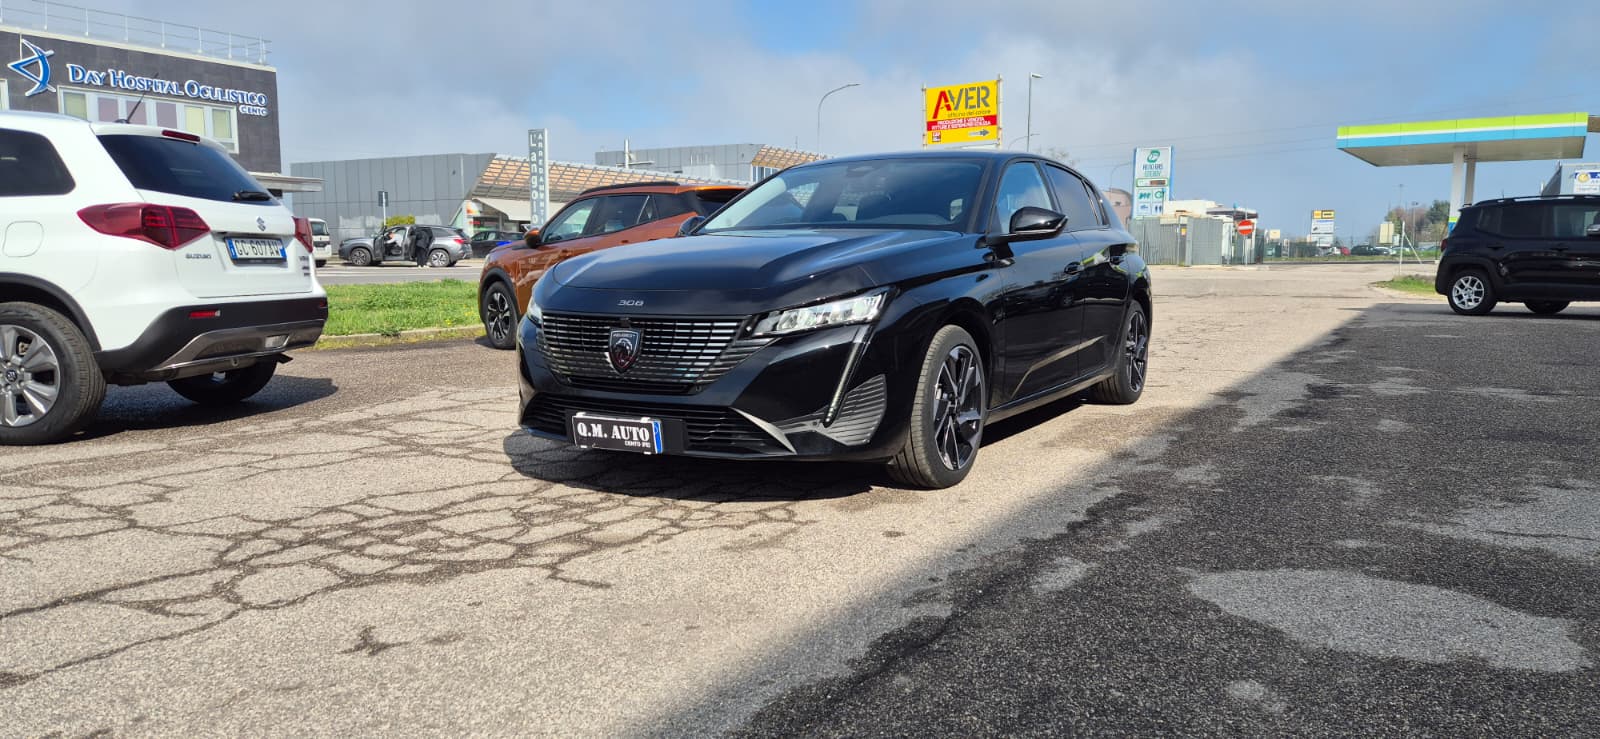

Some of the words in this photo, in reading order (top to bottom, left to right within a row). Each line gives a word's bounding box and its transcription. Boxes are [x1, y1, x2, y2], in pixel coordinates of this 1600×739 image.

[932, 86, 990, 119] AVER
[235, 240, 249, 256] GC
[577, 422, 608, 438] Q.M.
[611, 425, 650, 442] AUTO
